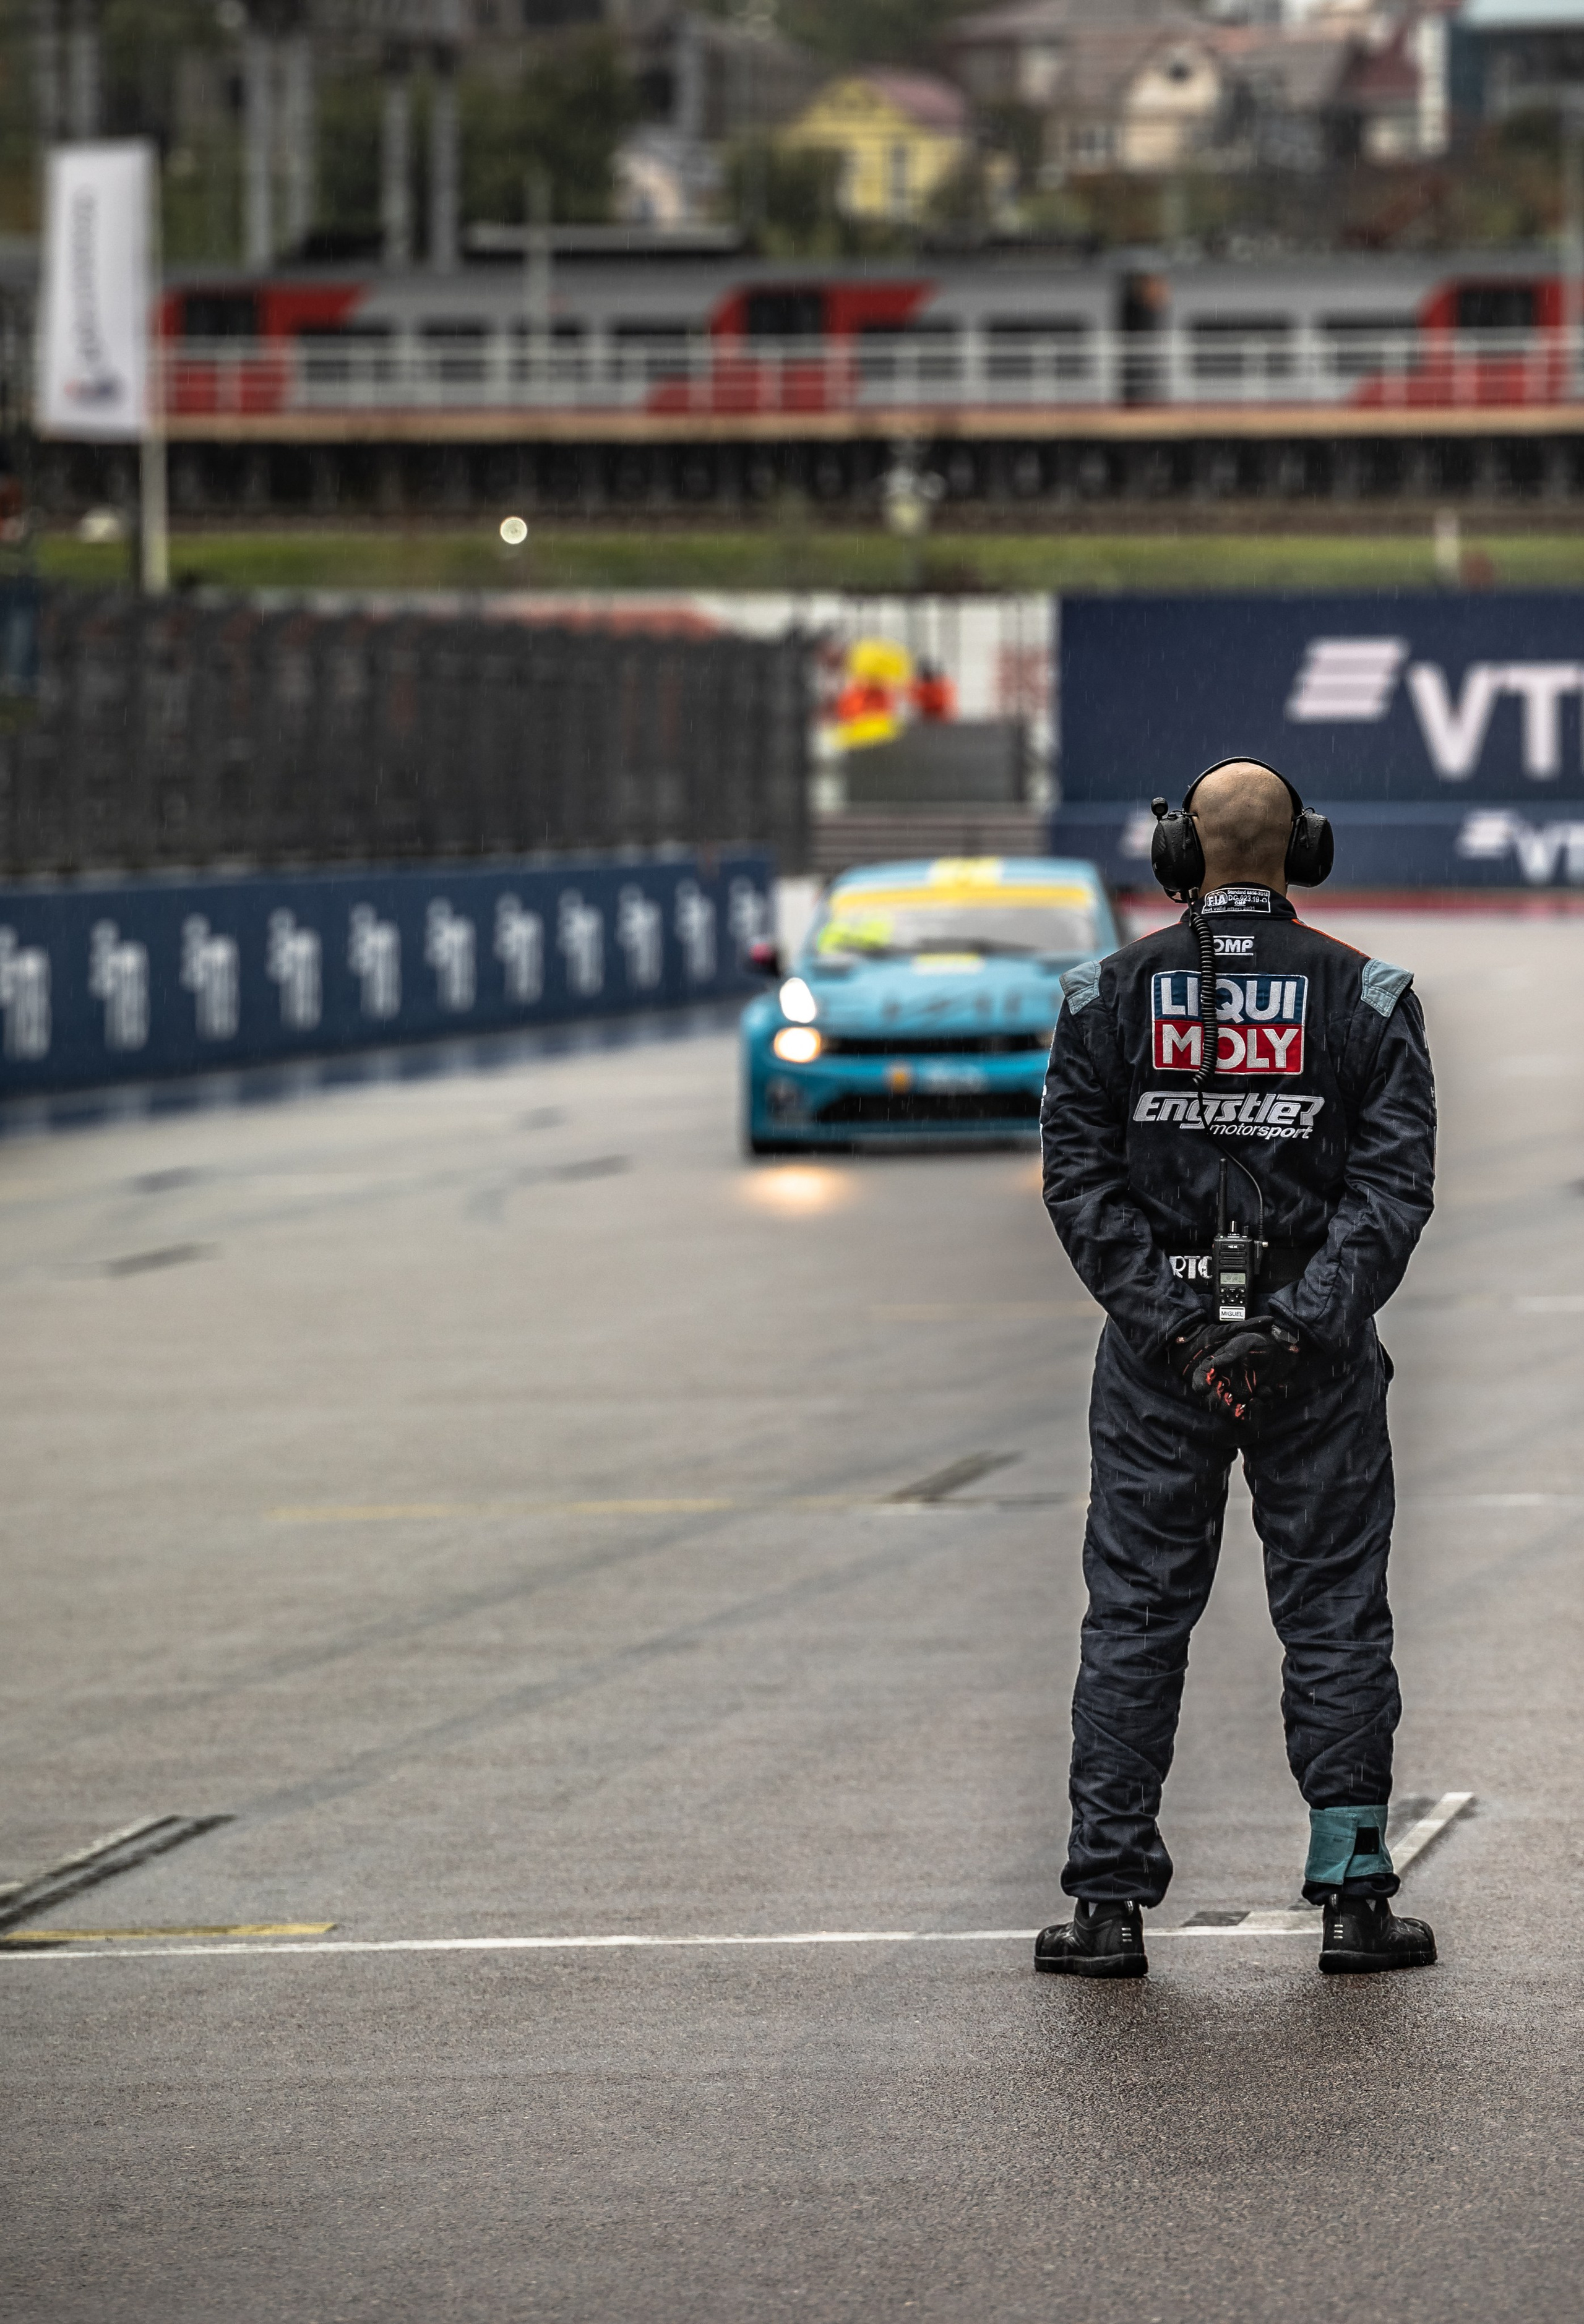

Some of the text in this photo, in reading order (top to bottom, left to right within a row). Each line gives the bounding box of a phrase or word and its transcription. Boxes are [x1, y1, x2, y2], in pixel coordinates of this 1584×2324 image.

[1405, 662, 1584, 779] VT
[1207, 894, 1226, 907] FIA
[1213, 938, 1254, 953] OMP
[1160, 977, 1297, 1024] LIQUI
[1162, 1024, 1299, 1070] MOLY
[1210, 1123, 1313, 1140] motorsport
